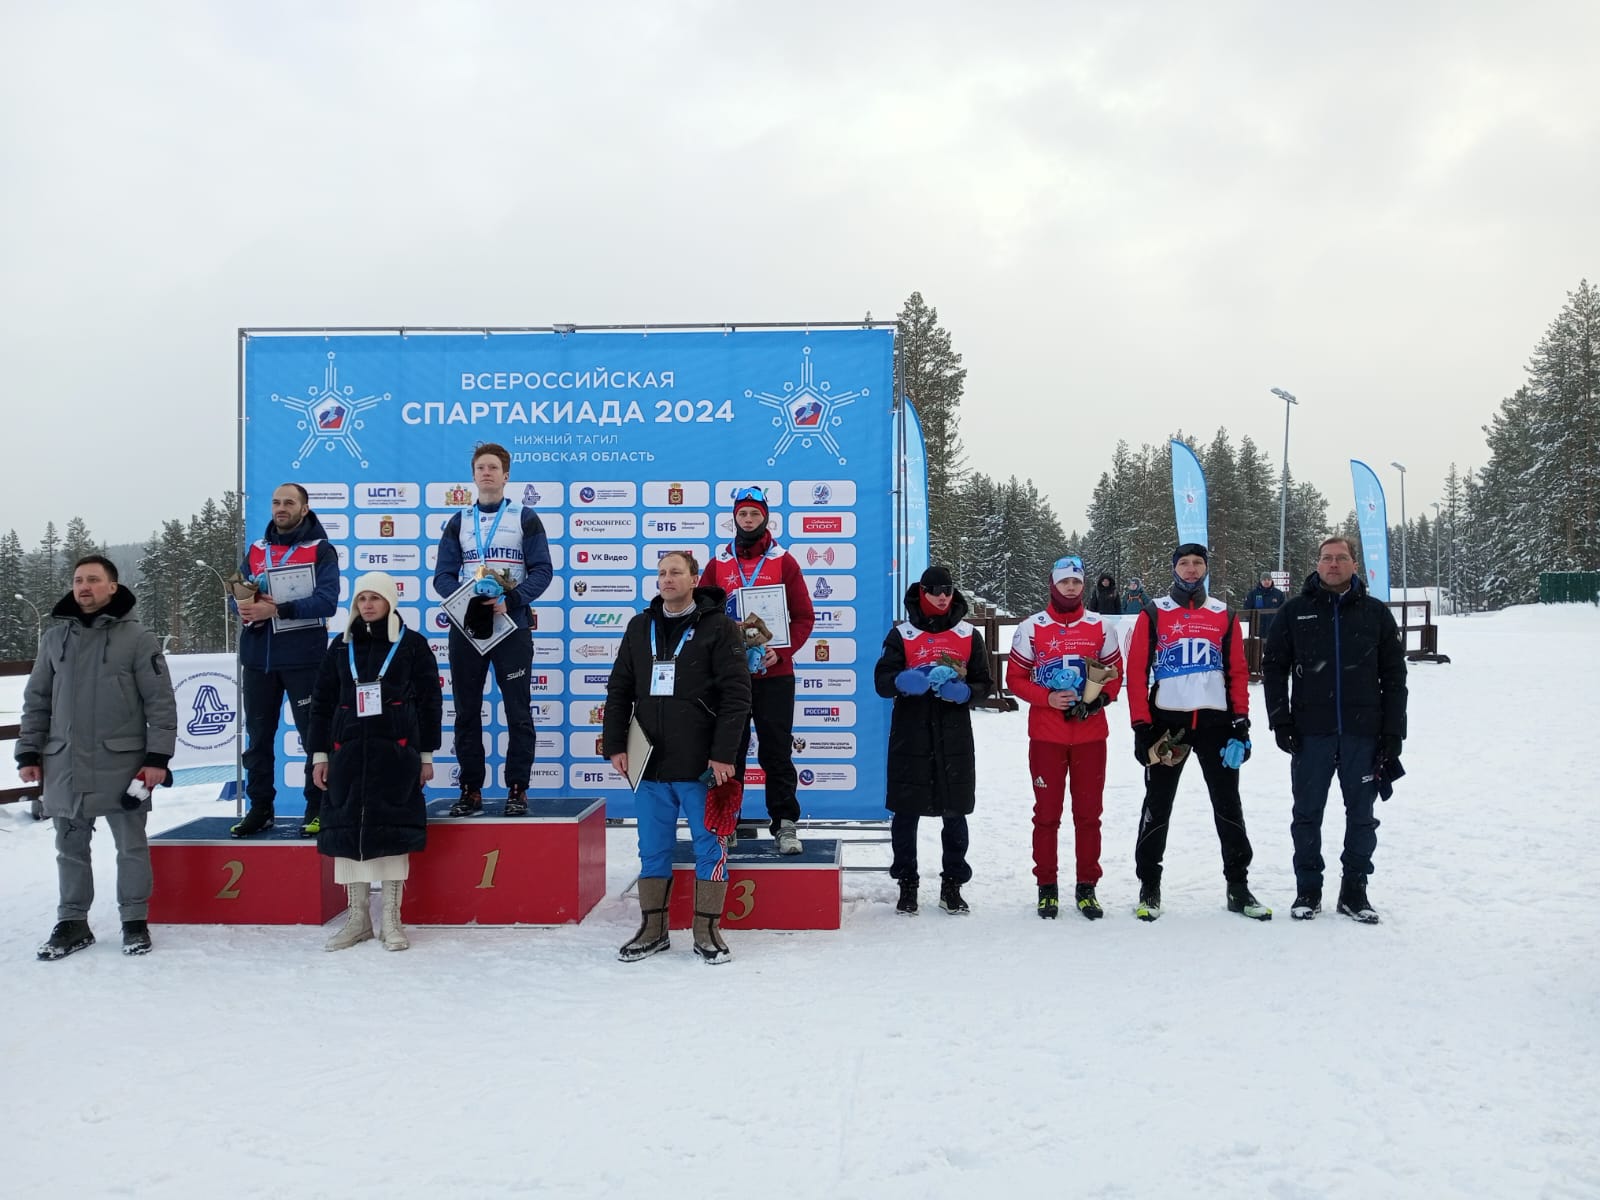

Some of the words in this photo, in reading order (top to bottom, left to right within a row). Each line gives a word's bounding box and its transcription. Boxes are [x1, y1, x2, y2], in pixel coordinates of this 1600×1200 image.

[461, 367, 674, 390] ВСЕРОССИЙСКАЯ
[401, 400, 645, 426] СПАРТАКИАДА
[654, 399, 735, 423] 2024
[514, 432, 572, 445] НИЖНИЙ
[576, 434, 618, 445] ТАГИЛ
[512, 451, 588, 464] ДЛОВСКАЯ
[591, 450, 655, 462] ОБЛАСТЬ
[367, 488, 396, 498] ЦСП
[657, 522, 677, 532] ВТБ
[368, 554, 388, 564] ВТБ
[591, 553, 602, 561] VK
[604, 553, 628, 562] Видео
[803, 679, 823, 689] ВТБ
[206, 714, 232, 723] 100
[584, 772, 604, 783] ВТБ
[475, 849, 500, 889] 1
[215, 860, 244, 899] 2
[726, 879, 756, 921] 3
